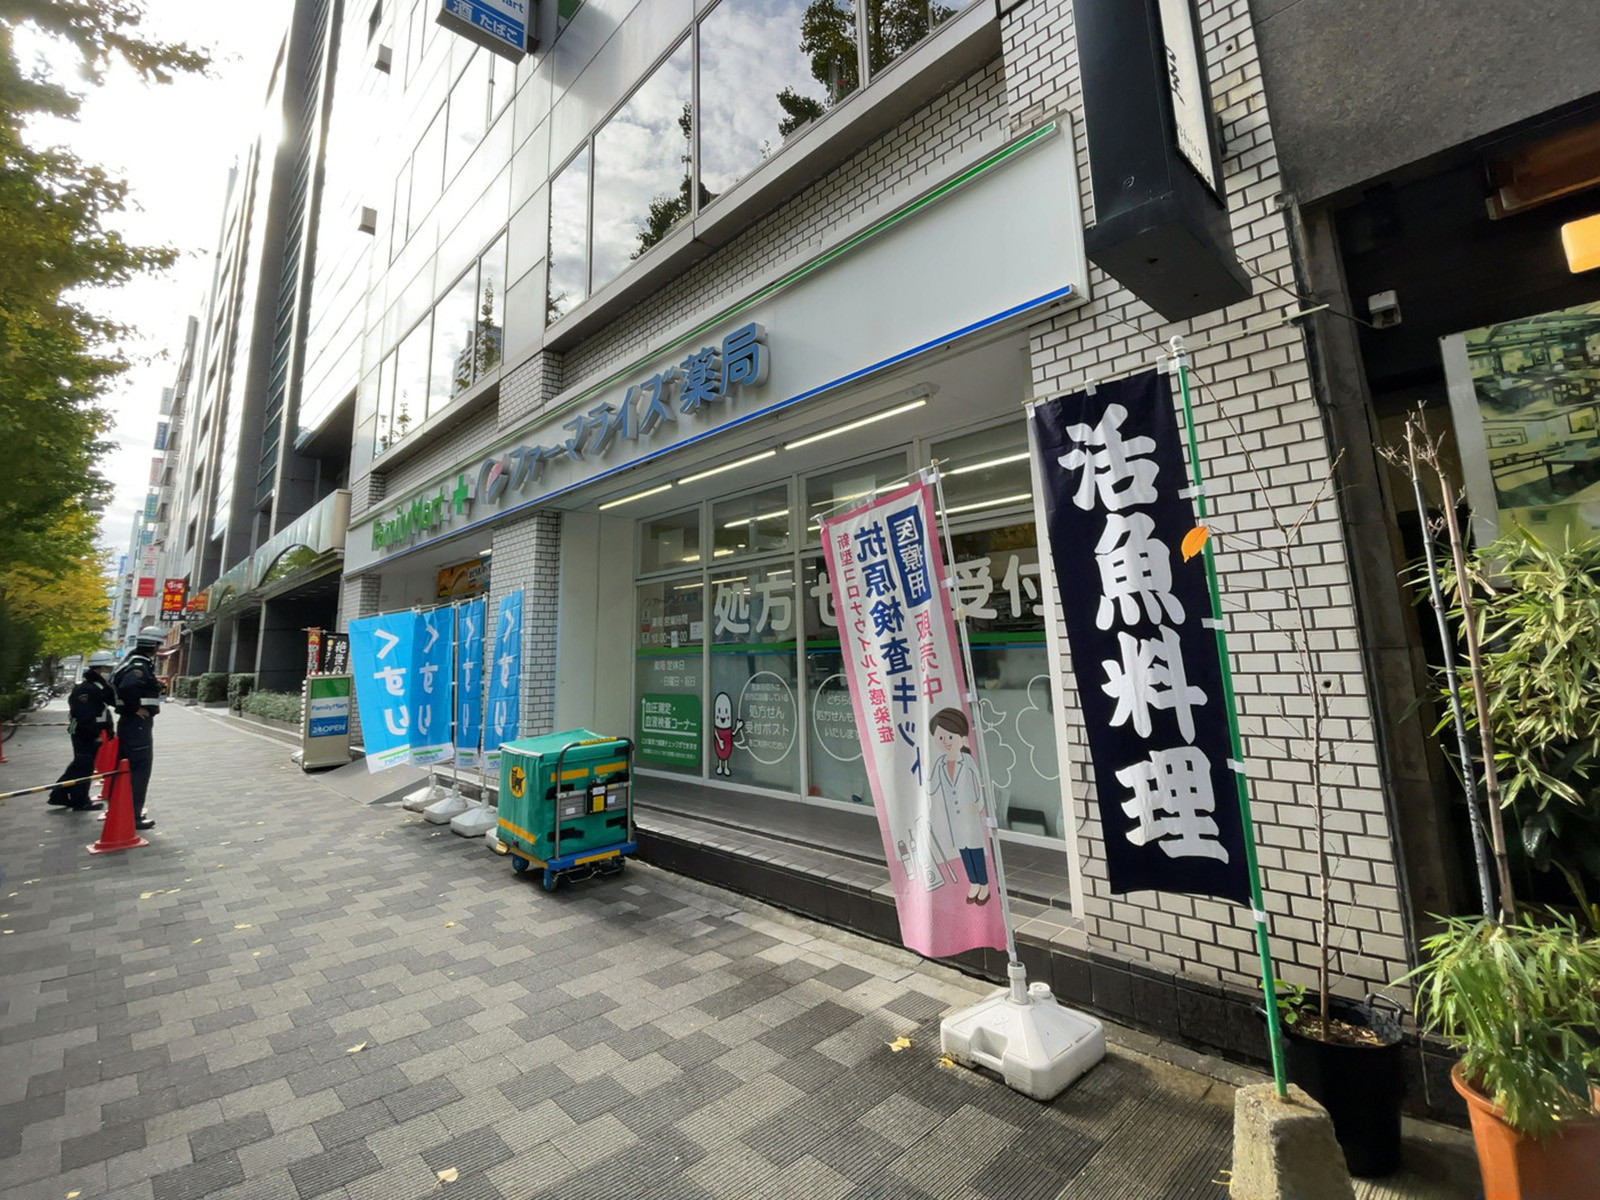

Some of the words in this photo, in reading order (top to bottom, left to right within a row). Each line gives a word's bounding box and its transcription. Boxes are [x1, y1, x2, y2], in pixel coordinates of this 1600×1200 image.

[453, 0, 474, 22] 酒
[480, 14, 518, 44] たばこ
[507, 322, 769, 491] ファーマライズ薬局
[371, 485, 445, 551] FamilyMart
[373, 628, 410, 736] くすり
[417, 624, 440, 736] くすり
[462, 617, 475, 737] くすり
[494, 609, 514, 737] くすり
[1058, 402, 1230, 866] 活魚料理
[311, 702, 348, 711] FamilyMart
[745, 722, 790, 737] 受付ポスト
[749, 705, 785, 720] 処方せん
